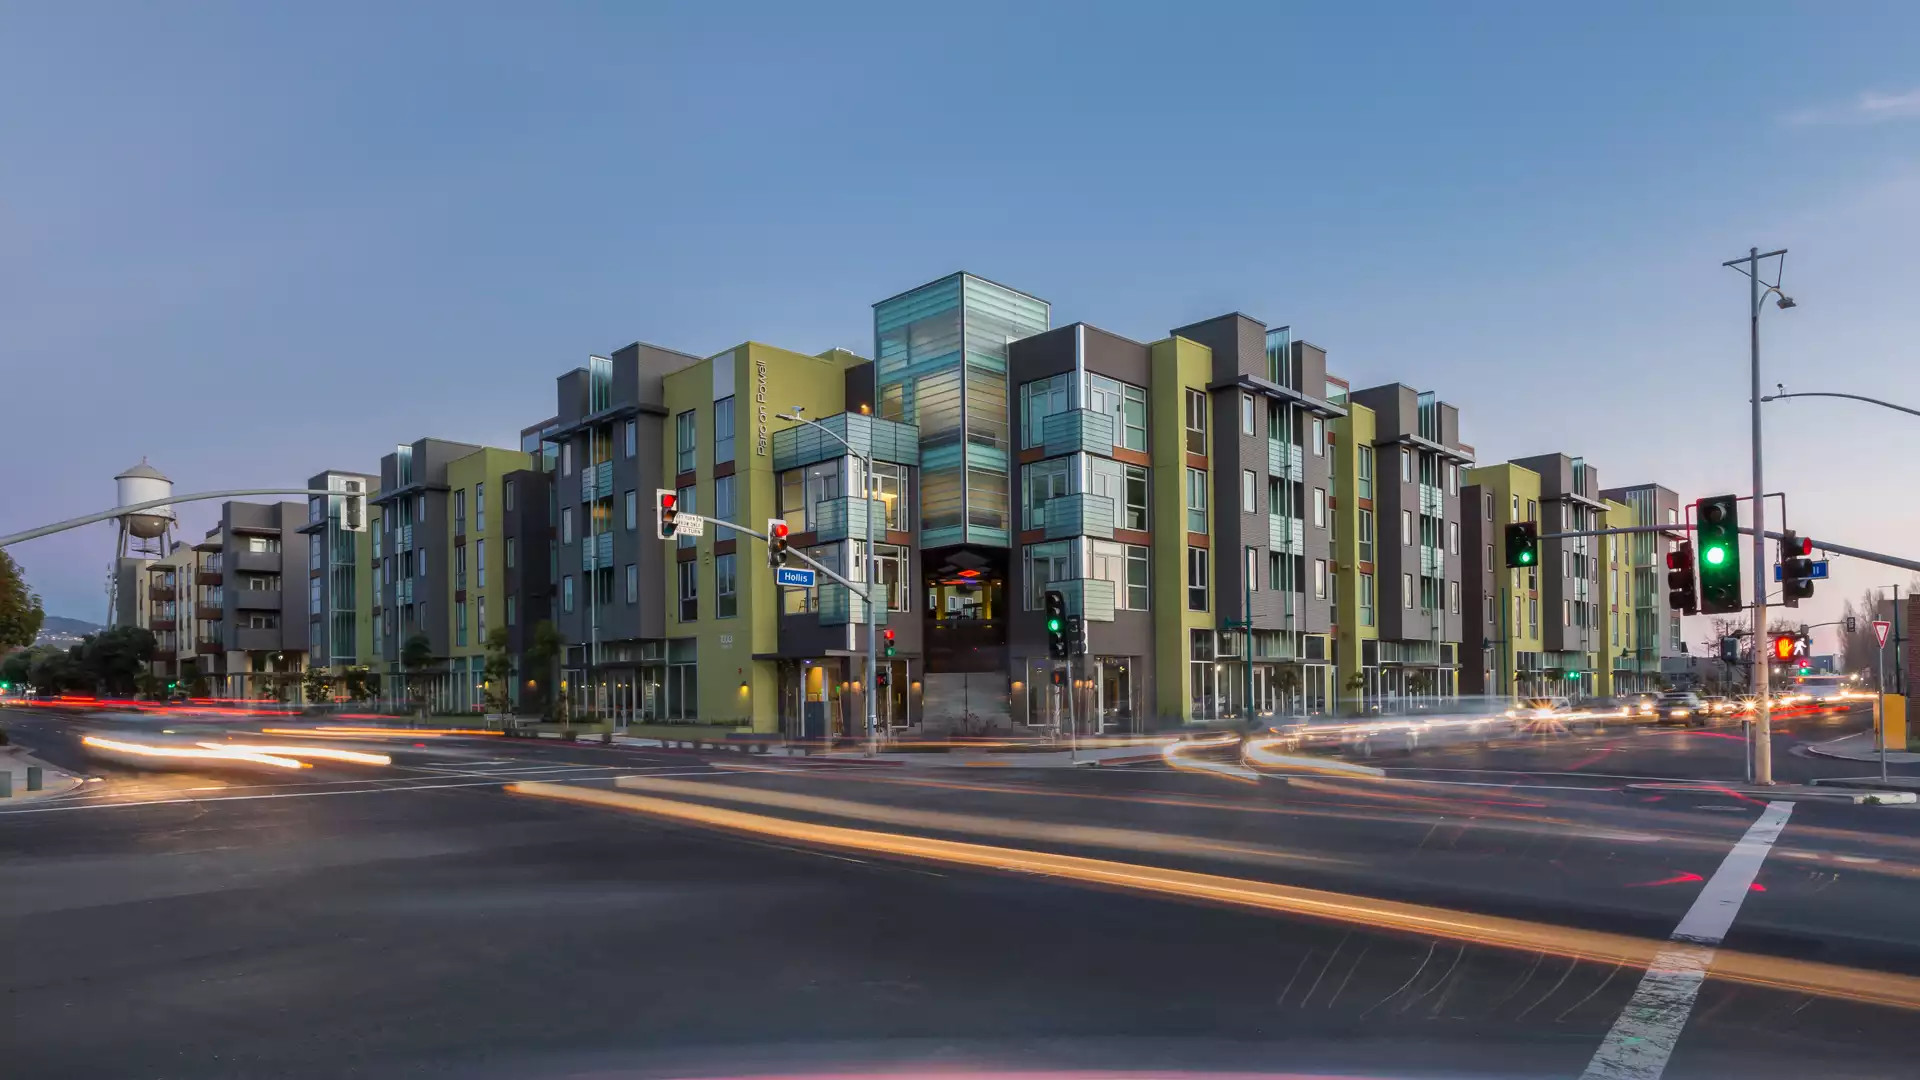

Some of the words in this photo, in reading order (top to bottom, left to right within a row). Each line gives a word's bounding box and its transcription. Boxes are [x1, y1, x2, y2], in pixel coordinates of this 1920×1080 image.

[756, 360, 766, 404] Powell
[759, 406, 766, 423] on
[756, 425, 766, 457] Parc
[784, 572, 808, 583] Hollis
